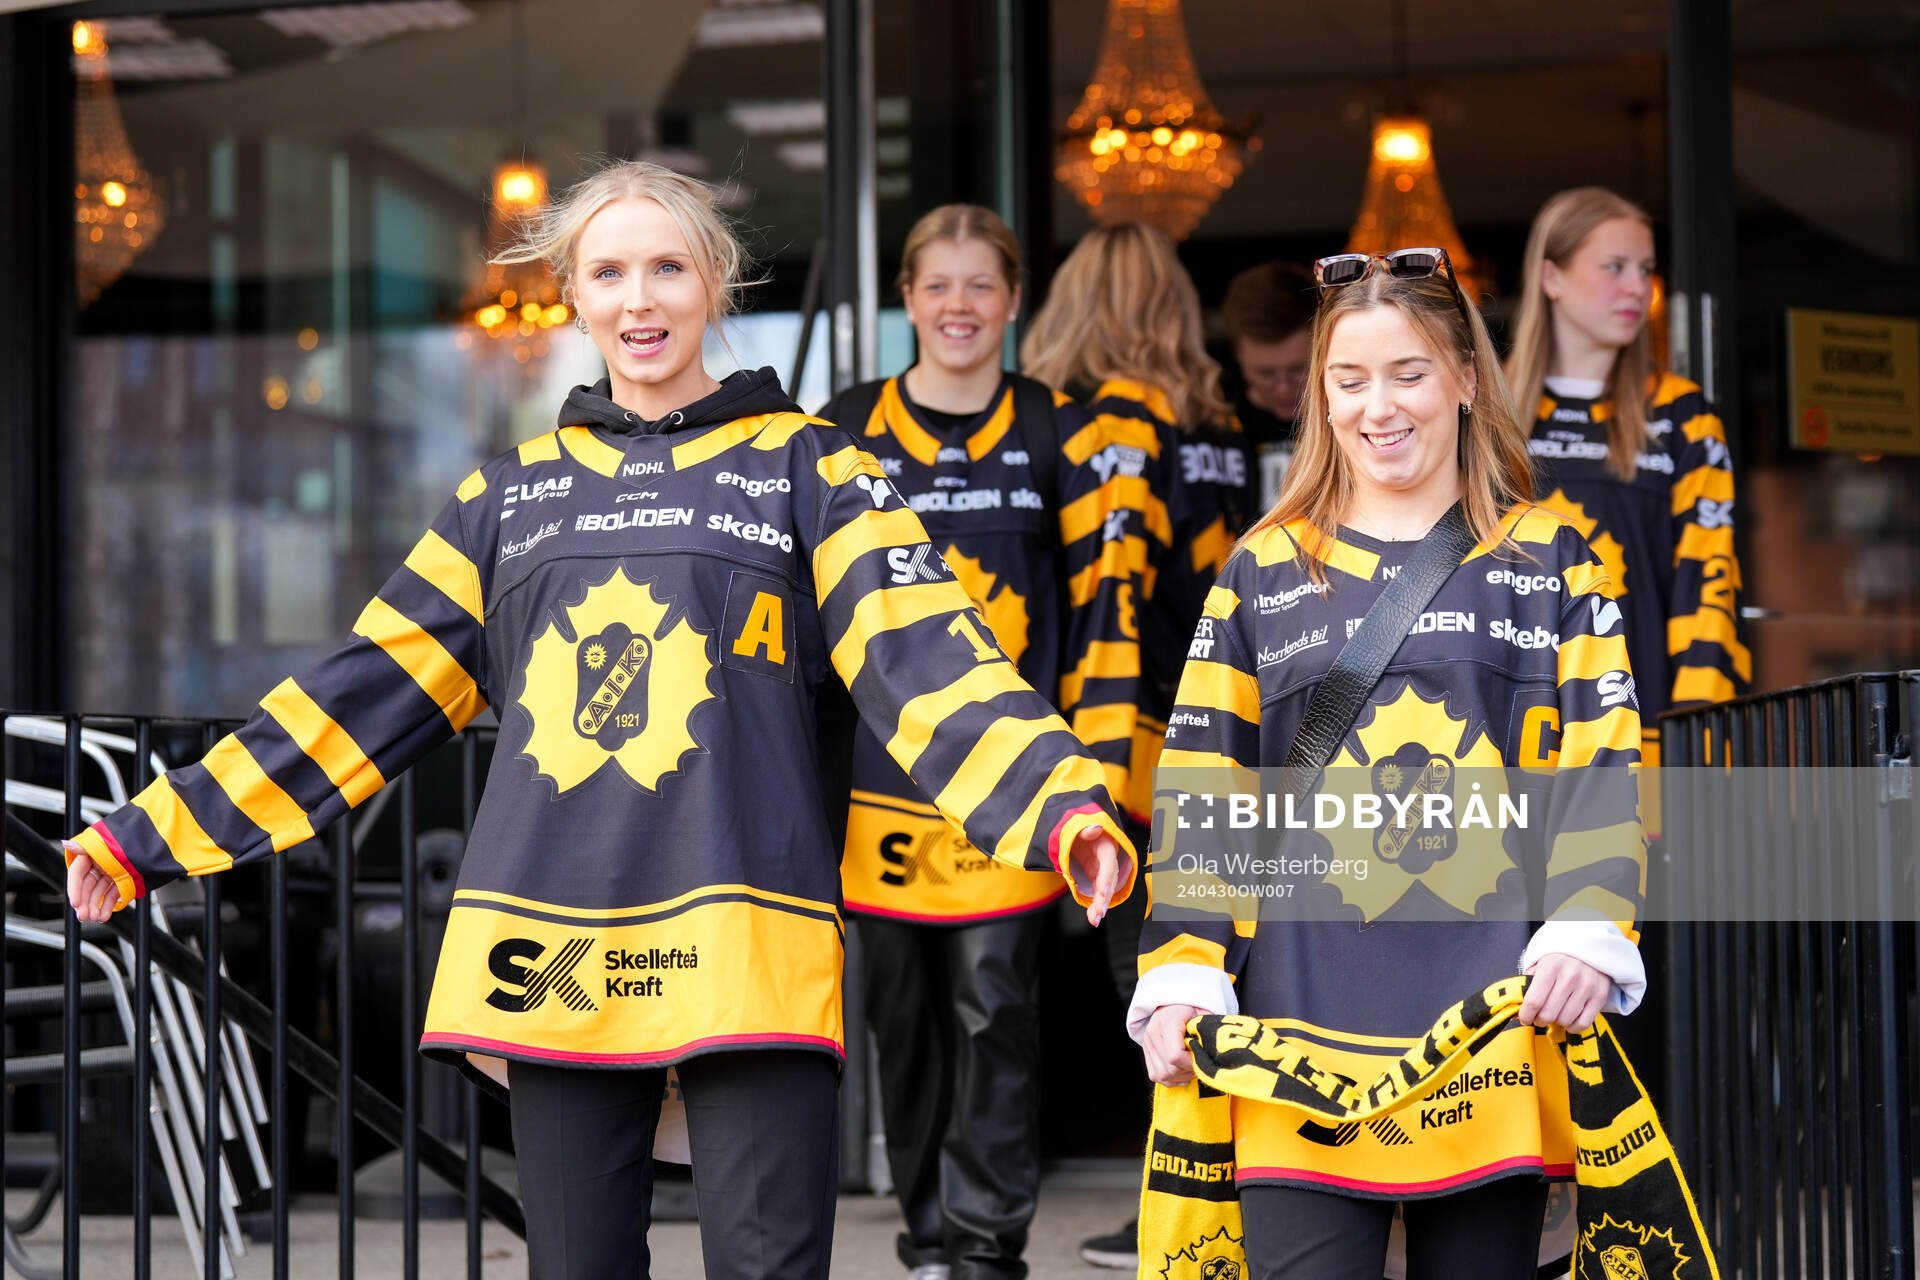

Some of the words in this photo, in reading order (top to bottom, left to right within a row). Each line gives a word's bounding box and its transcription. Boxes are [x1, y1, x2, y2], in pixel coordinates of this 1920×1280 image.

[622, 462, 665, 477] NDHL
[520, 475, 573, 501] LEAB
[538, 490, 570, 502] group
[615, 491, 659, 503] CCM
[715, 471, 792, 498] engco
[545, 518, 563, 535] Bil
[582, 507, 695, 531] BOLIDEN
[706, 513, 793, 554] skebo
[1485, 569, 1562, 596] engco
[732, 590, 786, 666] A
[1257, 631, 1309, 666] Norrlands
[1310, 624, 1328, 642] Bil
[614, 713, 640, 728] 1921
[1416, 834, 1448, 851] 1921
[605, 945, 699, 971] Skellefteå
[605, 975, 664, 998] Kraft
[1420, 1100, 1474, 1131] Kraft
